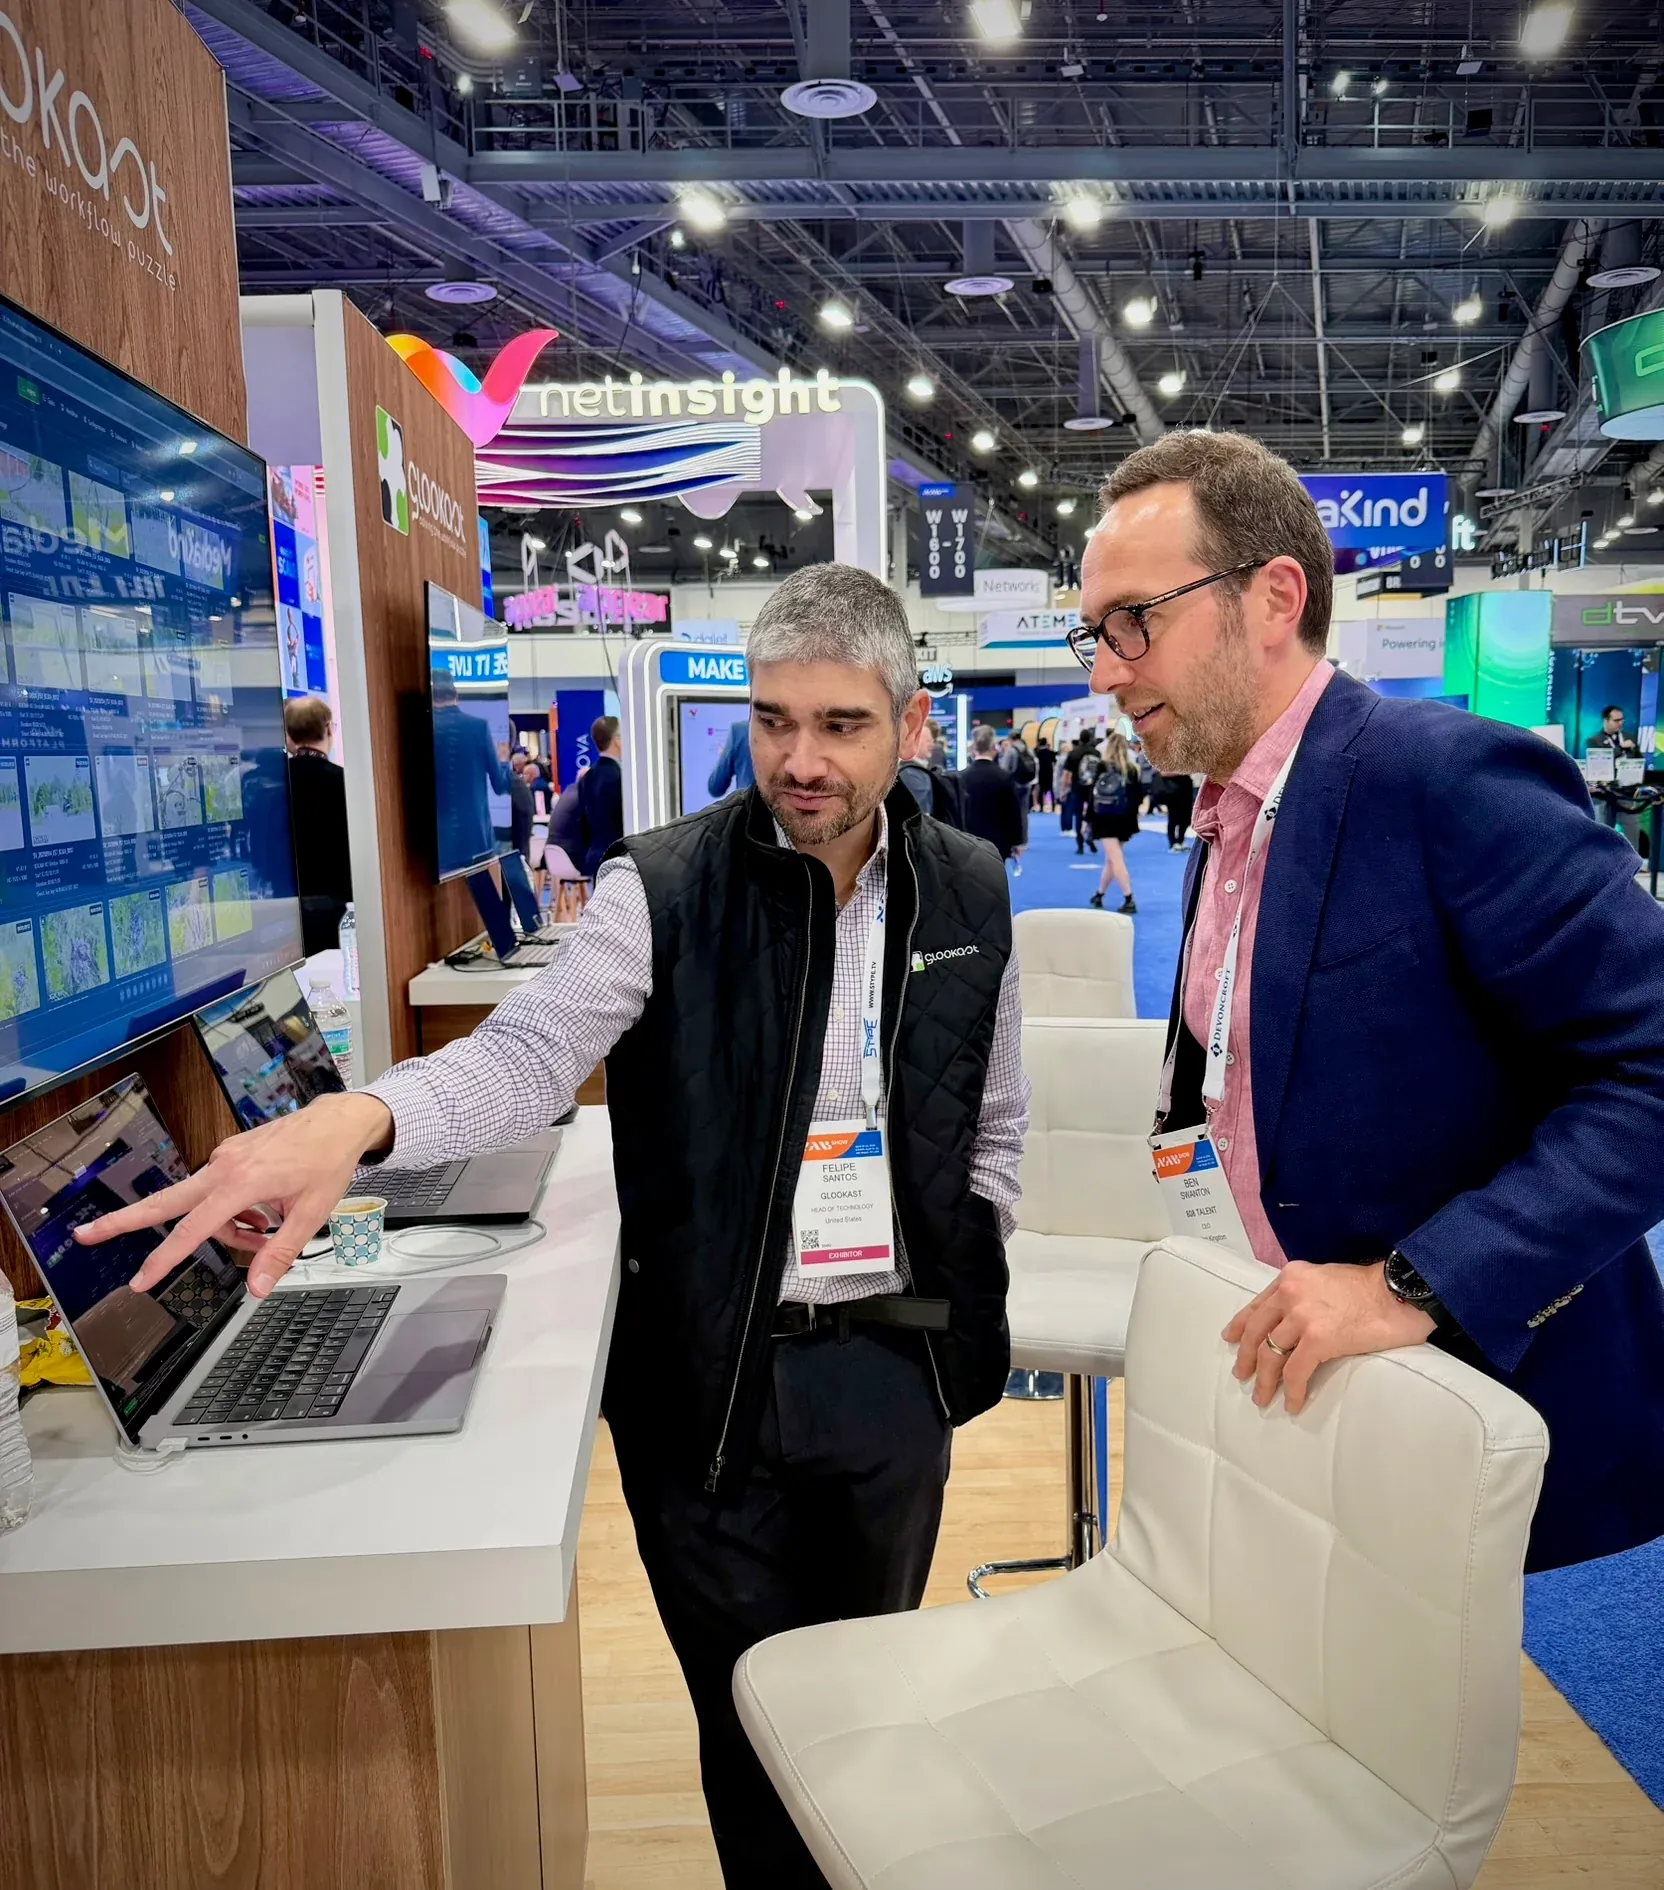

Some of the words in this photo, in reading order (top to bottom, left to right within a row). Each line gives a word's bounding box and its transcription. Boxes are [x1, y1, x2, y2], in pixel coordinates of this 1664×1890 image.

[45, 169, 121, 248] workflow
[128, 239, 176, 291] puzzle
[1016, 613, 1076, 629] ATEME
[1382, 638, 1436, 651] Powering
[687, 657, 745, 681] MAKE
[822, 1163, 856, 1173] FELIPE
[823, 1173, 858, 1183] SANTOS
[1183, 1177, 1199, 1188] BEN
[820, 1190, 862, 1200] GLOOKAST
[1180, 1187, 1211, 1200] SWANTON
[837, 1203, 873, 1211] TECHNOLOGY
[828, 1250, 863, 1259] EXHIBITOR
